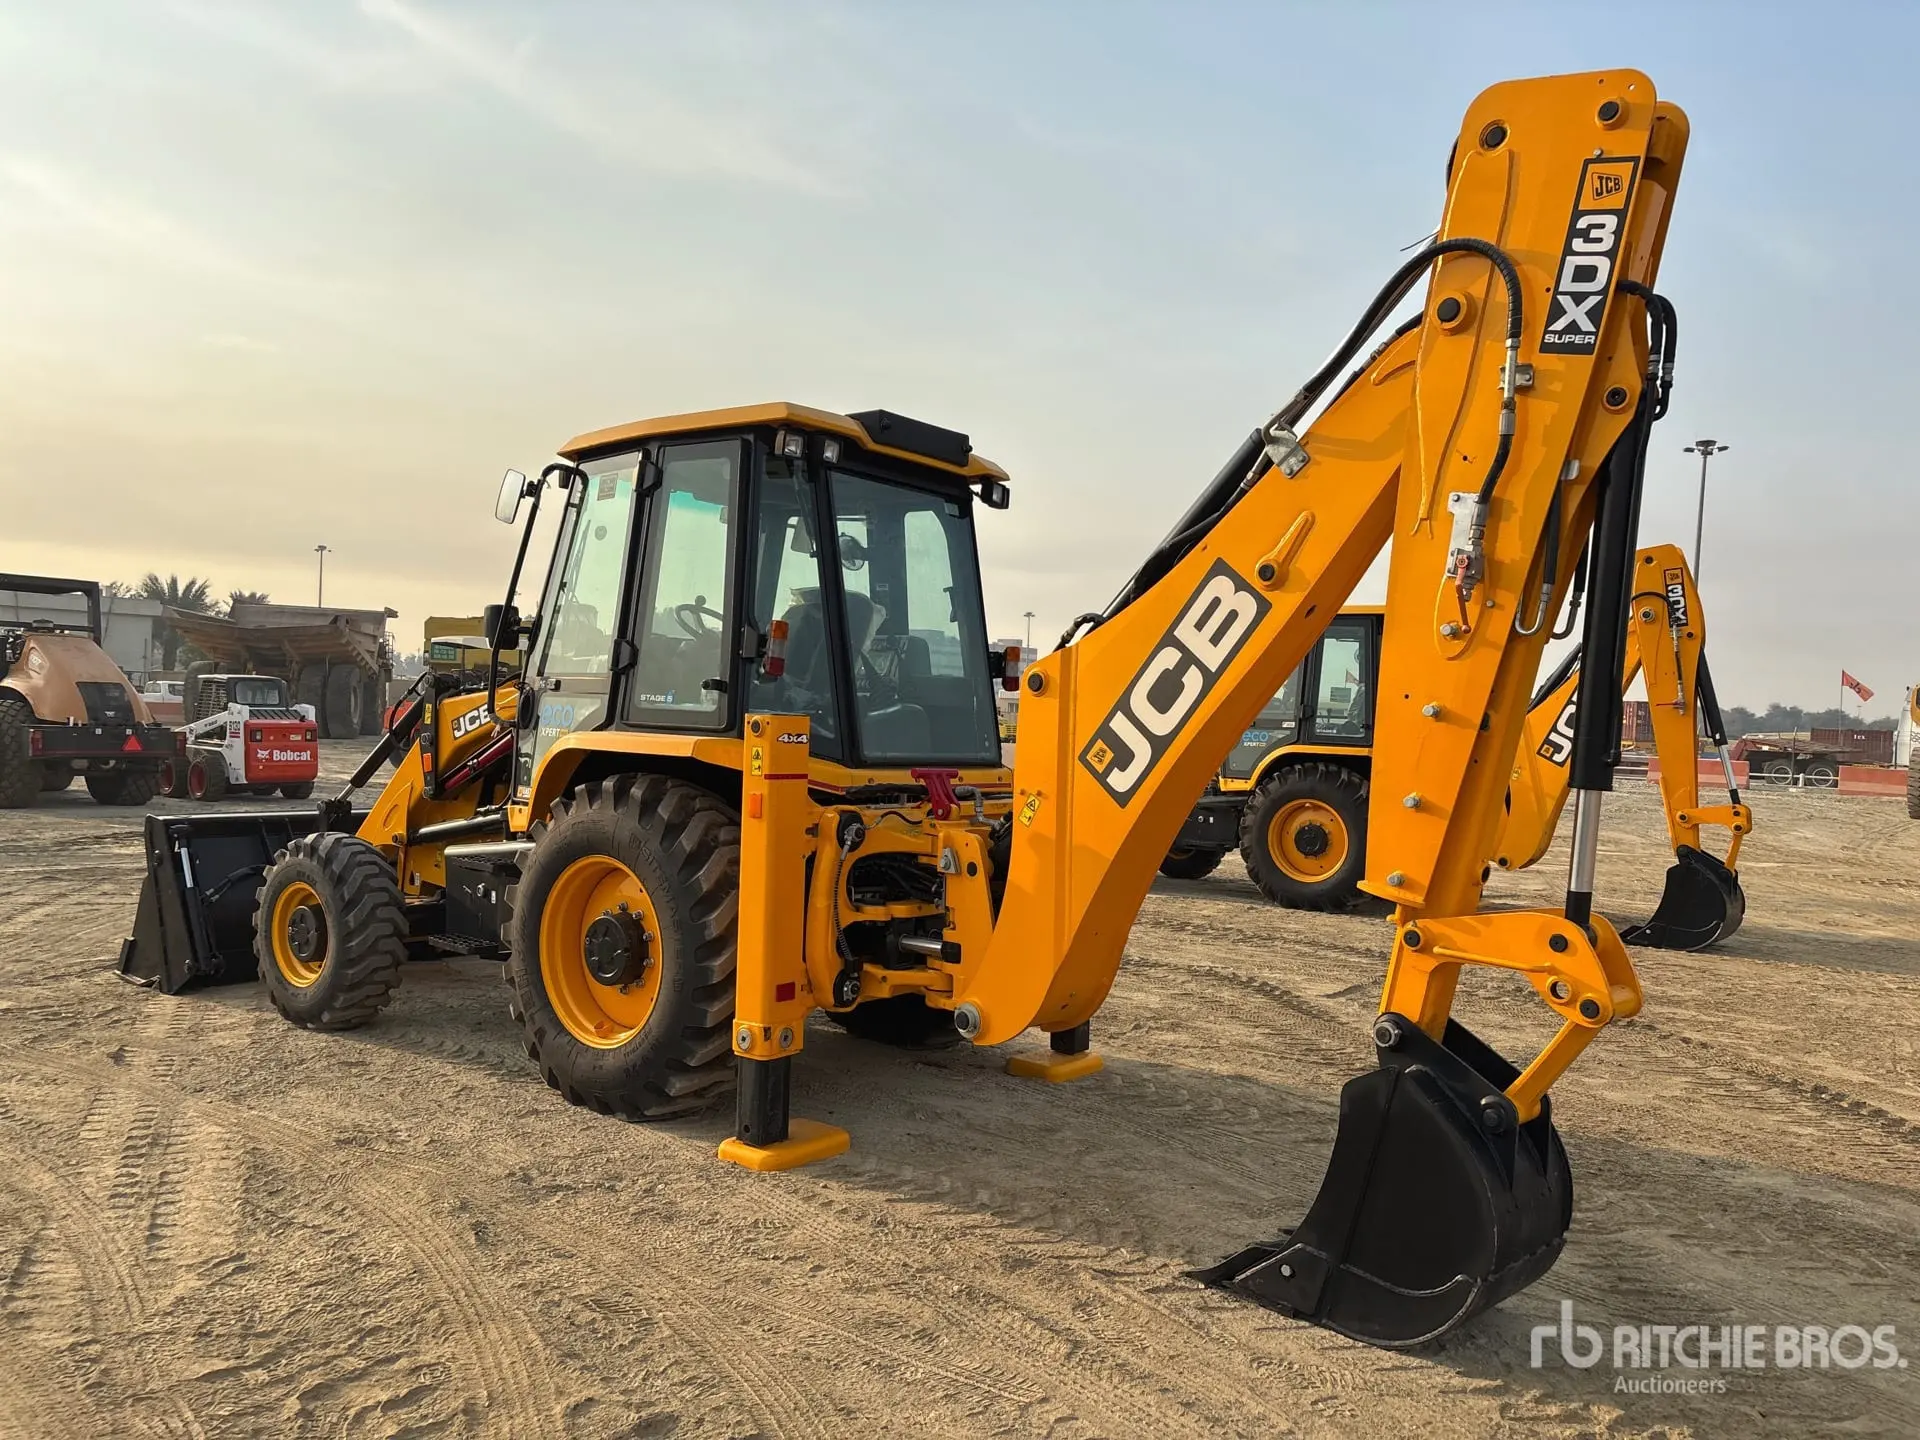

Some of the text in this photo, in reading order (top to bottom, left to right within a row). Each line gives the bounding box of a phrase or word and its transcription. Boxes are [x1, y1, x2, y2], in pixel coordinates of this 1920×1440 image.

[1594, 175, 1621, 198] JCB
[1547, 214, 1618, 332] 3DX
[1544, 333, 1596, 345] SUPER
[1106, 575, 1258, 793] JCB
[640, 694, 665, 702] STAGE
[540, 727, 560, 738] XPERT
[1549, 690, 1578, 763] JC
[273, 749, 311, 761] Bobcat
